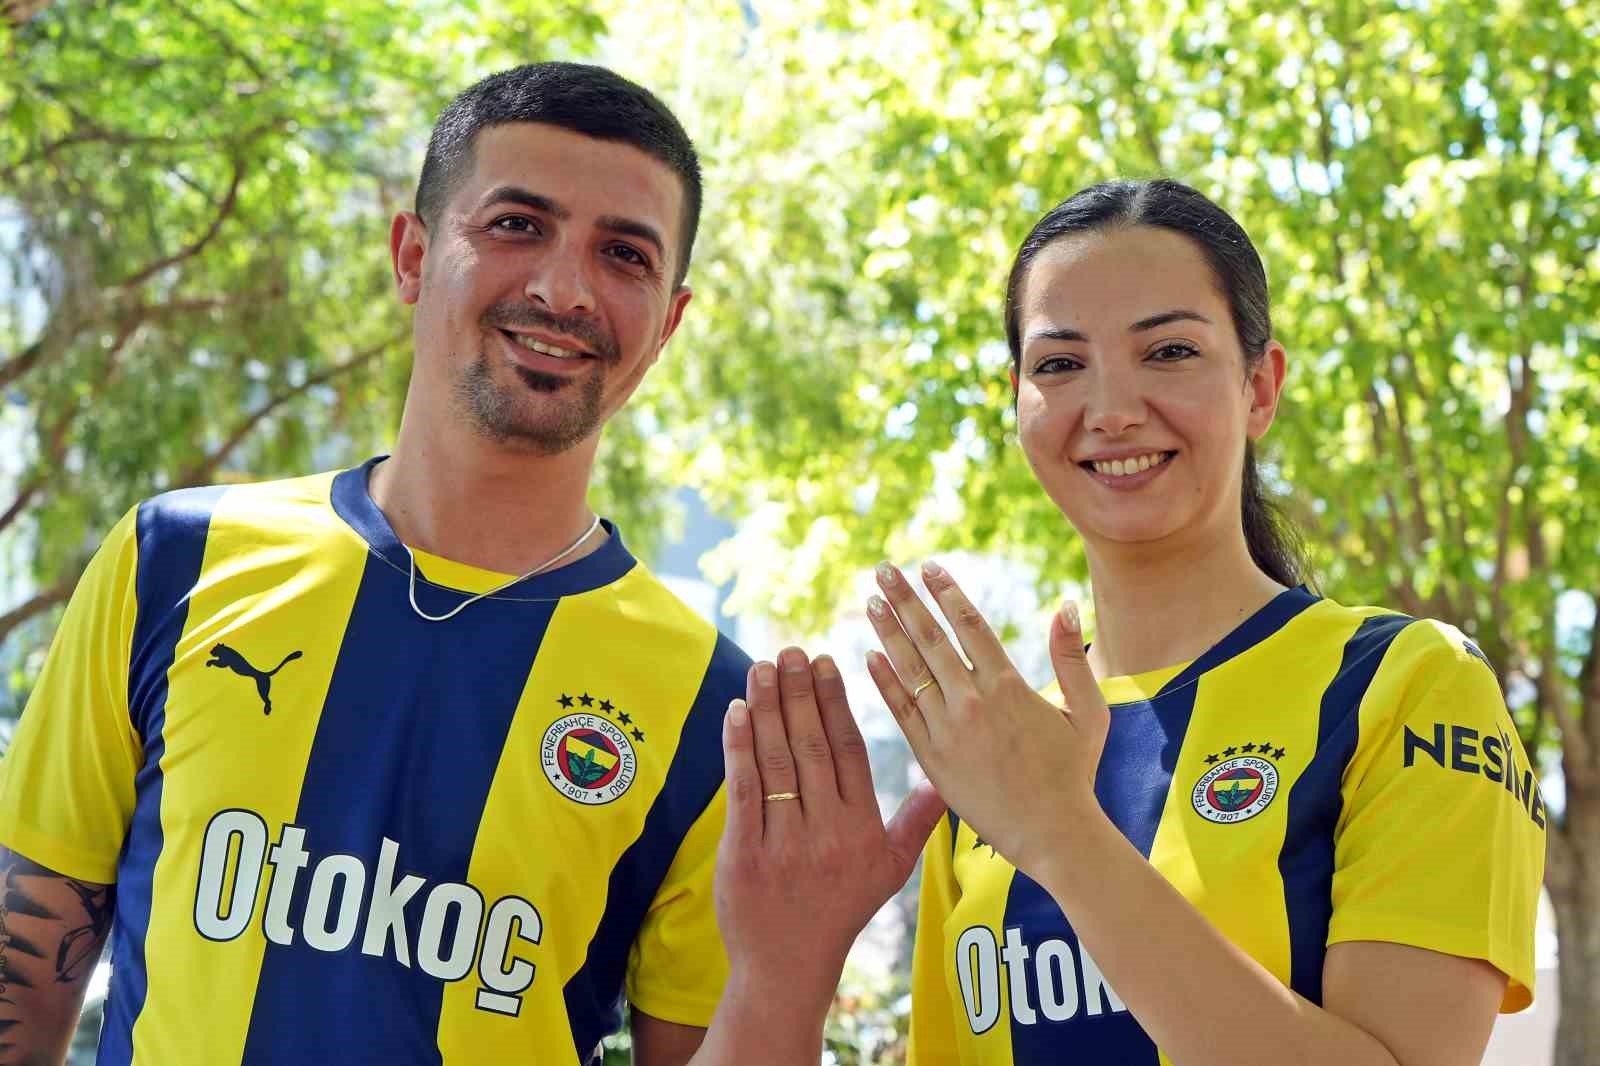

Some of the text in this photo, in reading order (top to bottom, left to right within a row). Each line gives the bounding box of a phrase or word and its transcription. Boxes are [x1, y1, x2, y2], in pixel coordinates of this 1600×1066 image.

[544, 717, 593, 766] FENERBAHÇE
[601, 723, 627, 749] SPOR
[1243, 760, 1268, 773] SPOR
[563, 784, 587, 800] 1907
[1215, 812, 1239, 820] 1907
[194, 808, 543, 1017] Otokoç
